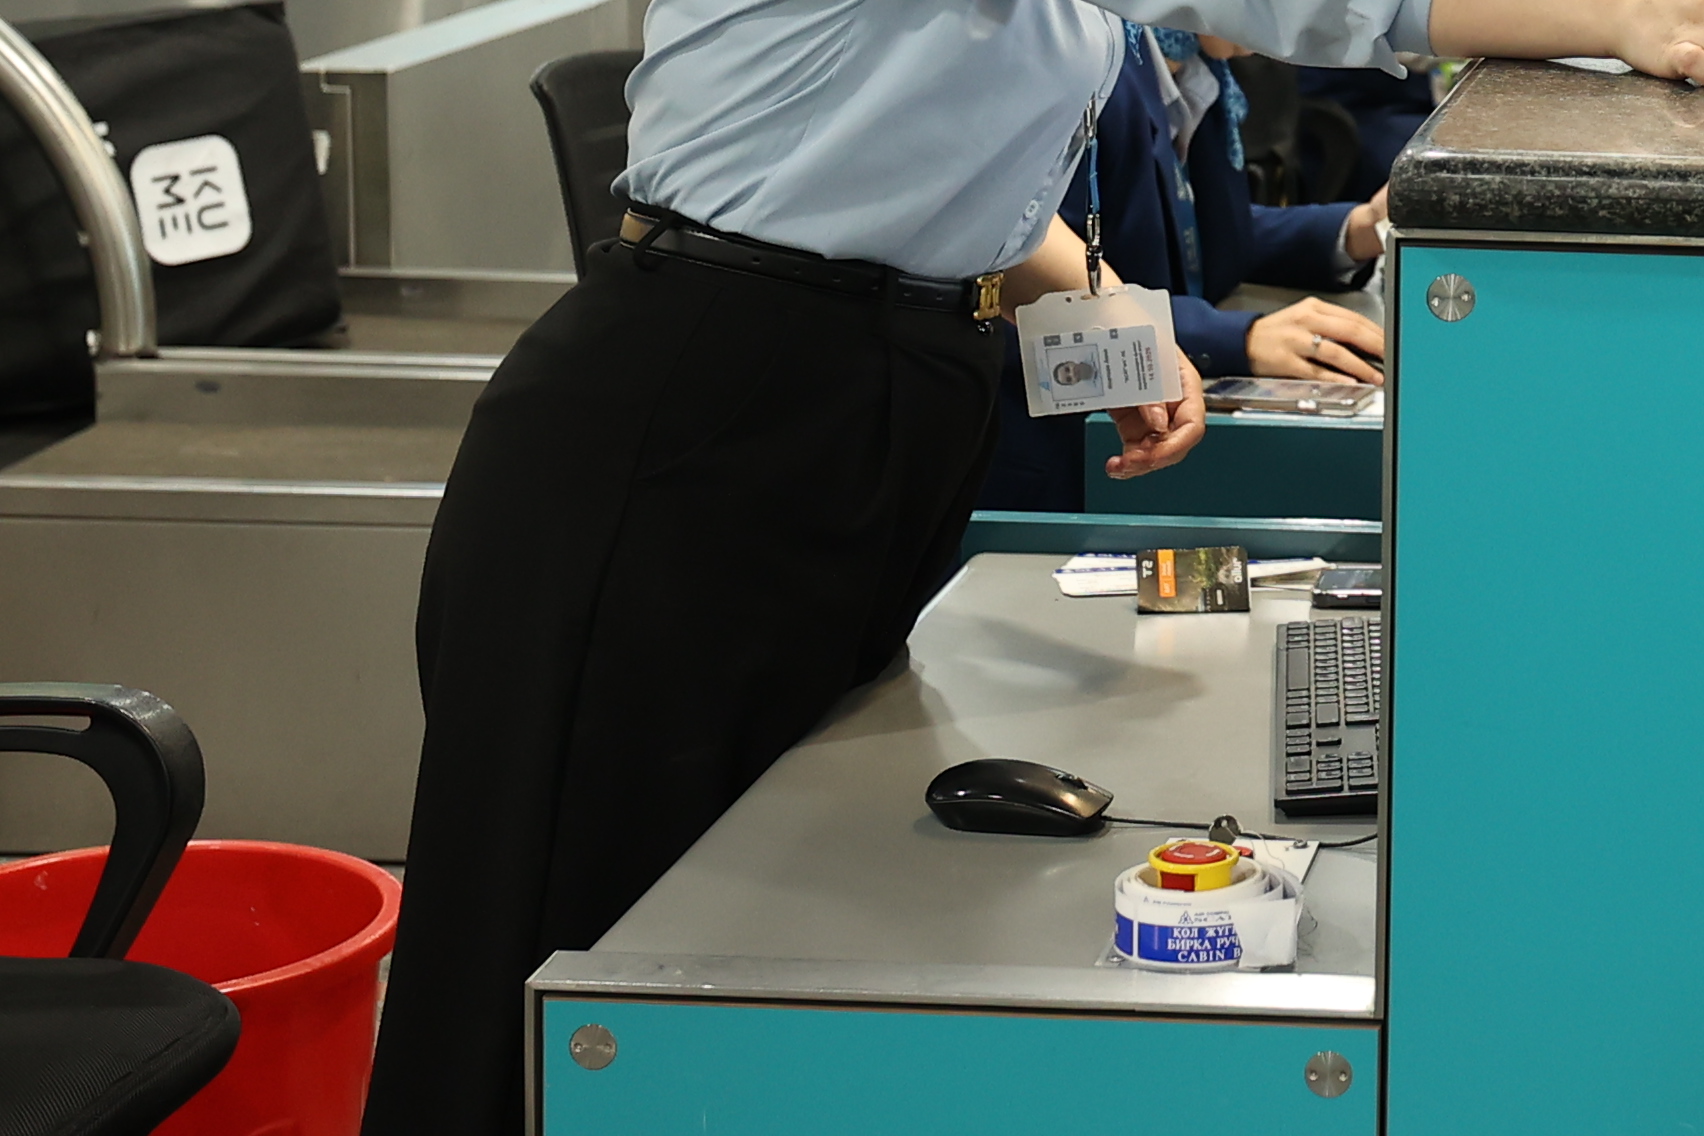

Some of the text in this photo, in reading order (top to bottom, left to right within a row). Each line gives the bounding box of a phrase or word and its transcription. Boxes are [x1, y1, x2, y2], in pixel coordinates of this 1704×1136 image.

[151, 174, 193, 240] ME
[189, 166, 229, 231] KU
[1232, 556, 1243, 583] allur
[1167, 939, 1211, 950] БИРКА
[1178, 950, 1225, 962] CABIN
